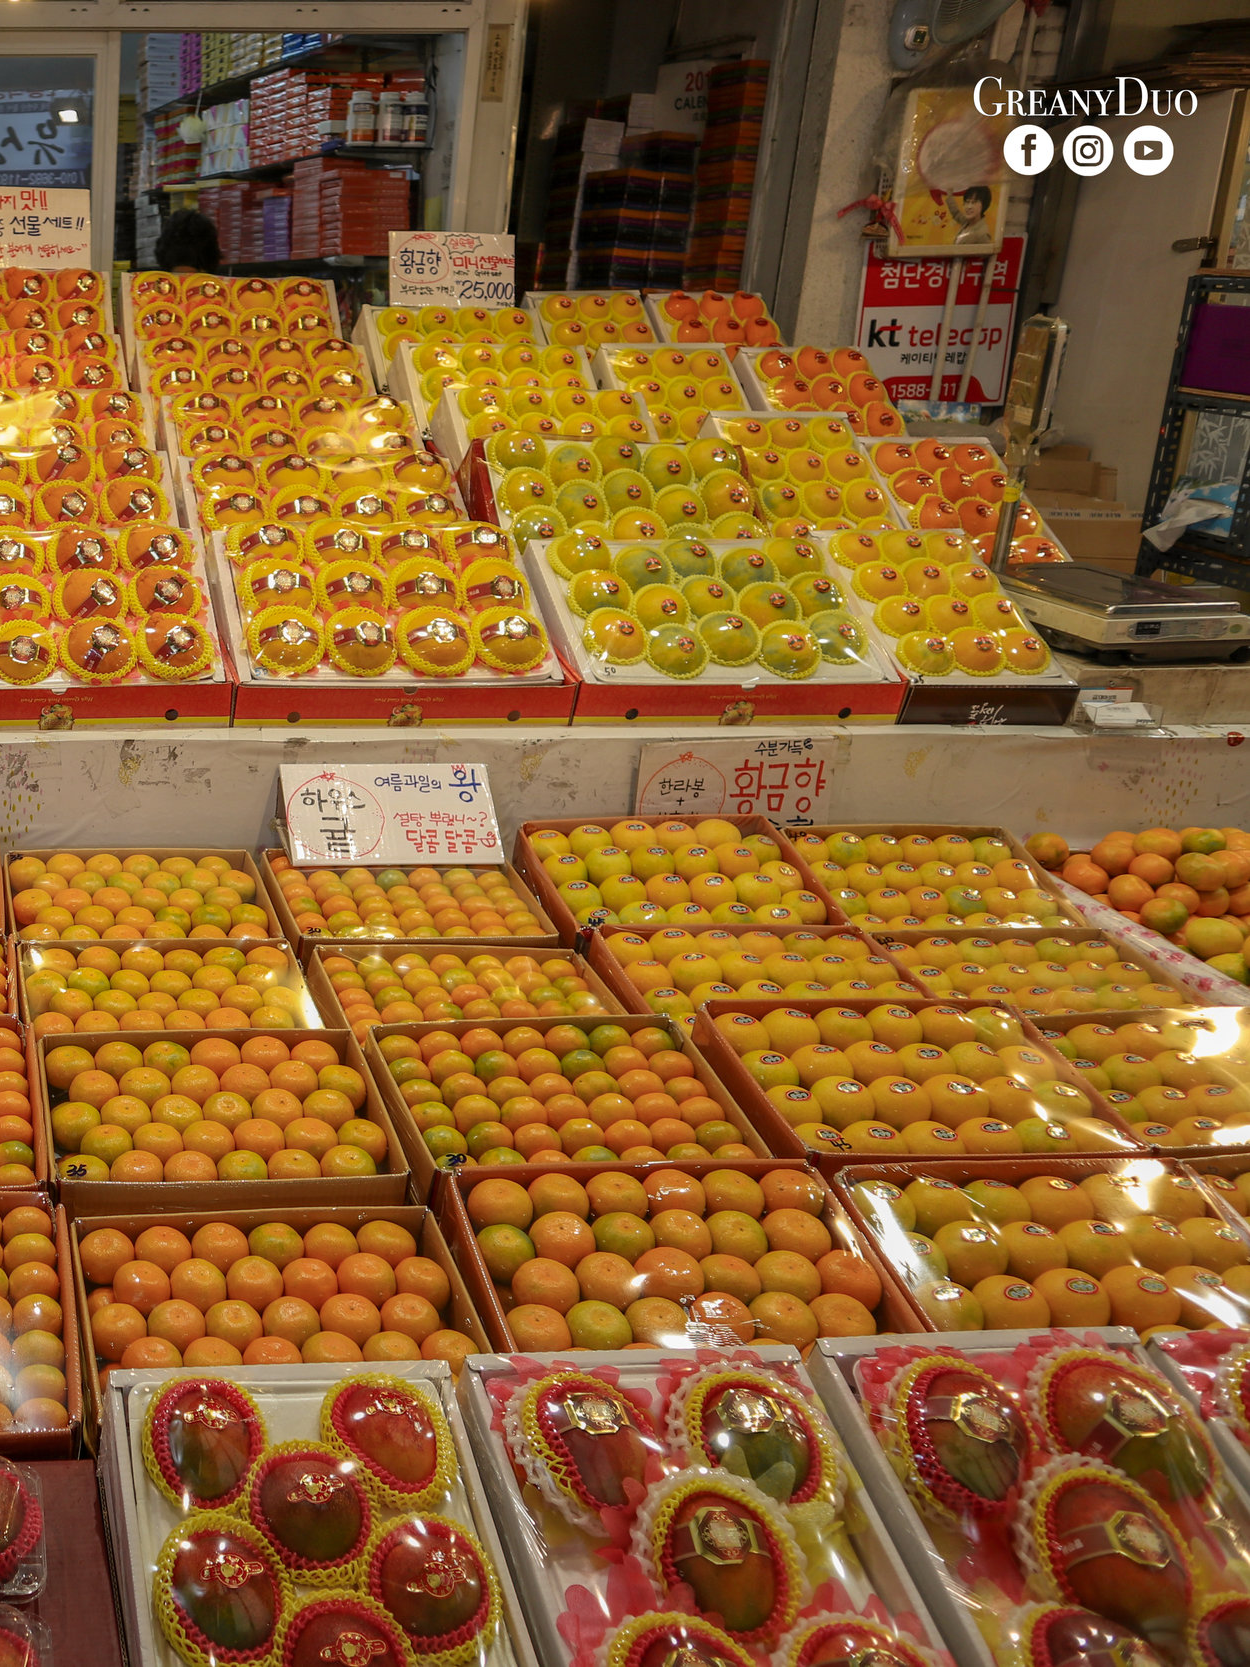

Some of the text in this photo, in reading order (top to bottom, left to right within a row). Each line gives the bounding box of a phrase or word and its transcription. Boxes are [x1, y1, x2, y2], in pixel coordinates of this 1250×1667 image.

[685, 70, 709, 93] 20
[20, 189, 50, 211] 맛!!
[399, 248, 442, 275] 황금향
[867, 318, 903, 348] kt
[900, 351, 968, 365] 케이티레캅
[604, 666, 617, 676] 50
[754, 740, 803, 757] 수분가득
[374, 768, 481, 803] 여름과일의 왕
[659, 757, 826, 814] 한라봉 황금향
[393, 811, 426, 827] 설탕
[406, 829, 478, 854] 달콤 달콤
[306, 926, 322, 934] 30
[829, 1137, 852, 1150] 45
[445, 1153, 467, 1166] 30
[66, 1163, 87, 1177] 35
